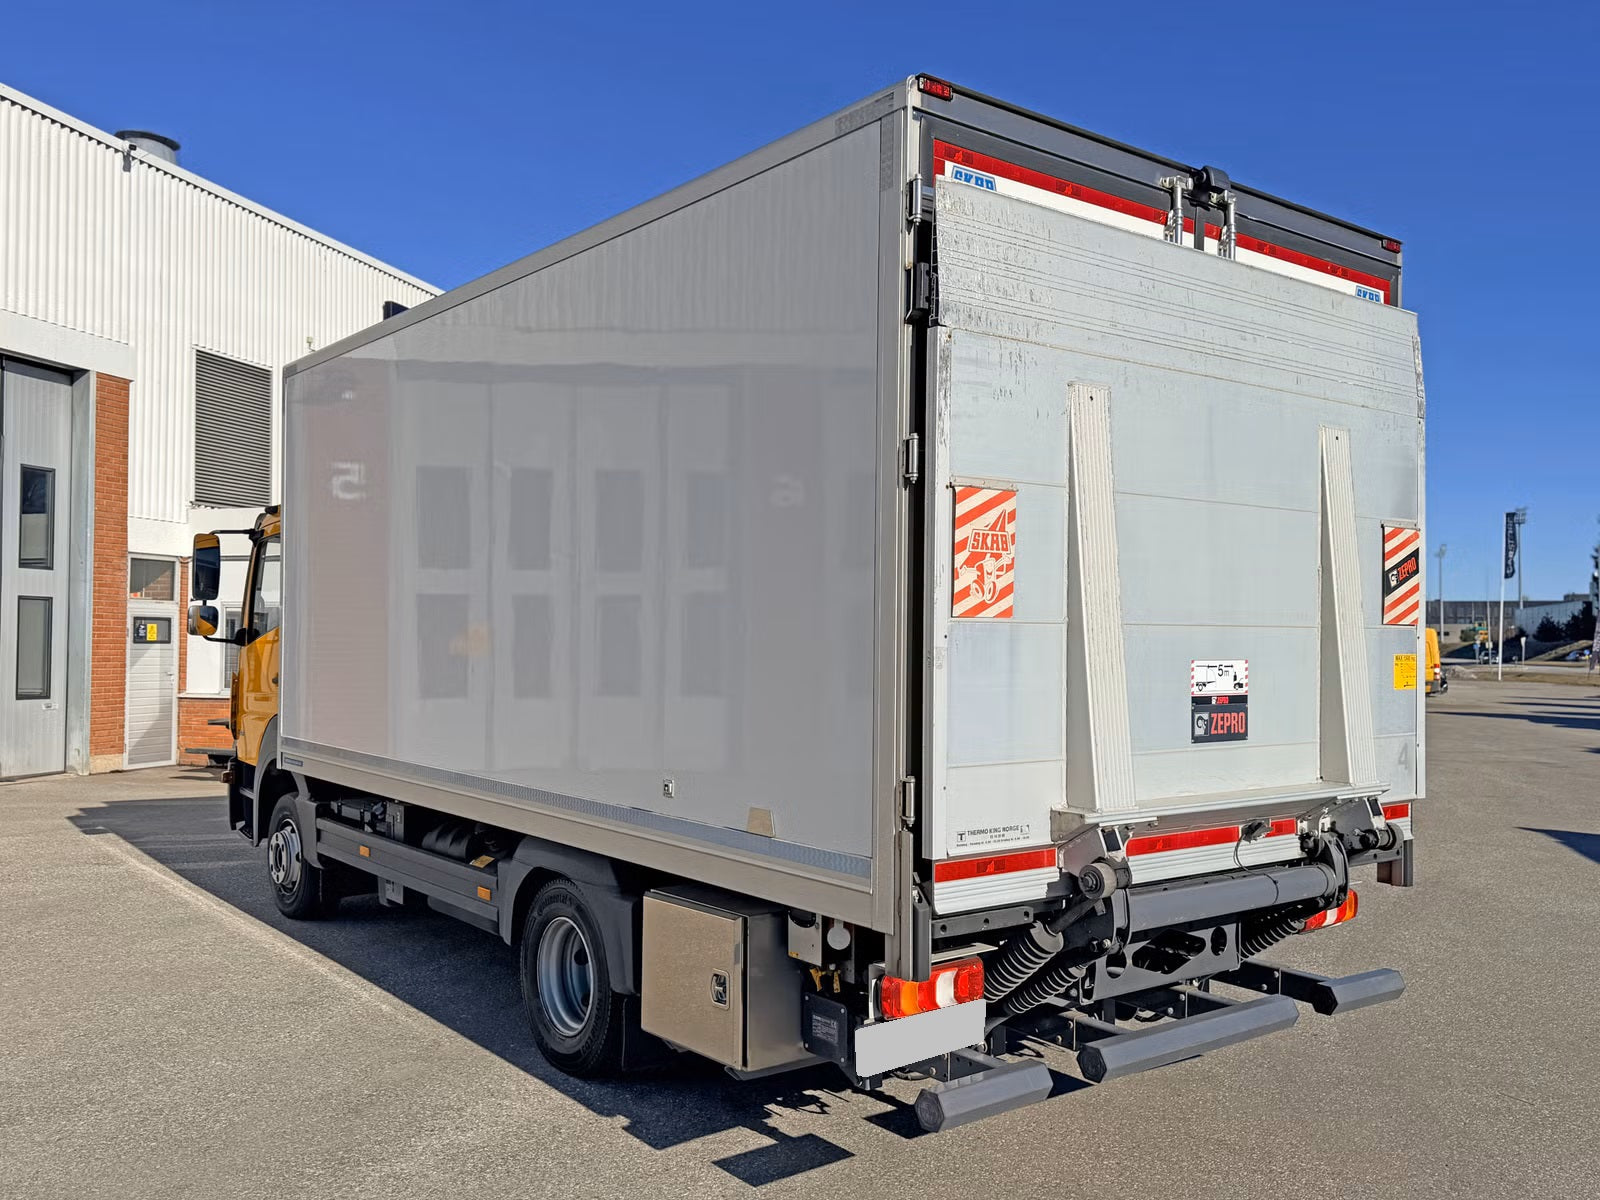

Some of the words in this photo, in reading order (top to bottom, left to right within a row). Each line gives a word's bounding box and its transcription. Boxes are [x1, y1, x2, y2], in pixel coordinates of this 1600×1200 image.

[971, 532, 1009, 552] SKAB
[1397, 557, 1417, 581] ZEPRO
[1217, 664, 1224, 677] 5
[1216, 696, 1229, 704] ZEPRO
[1211, 711, 1246, 734] ZEPRO
[967, 828, 989, 836] THERMO
